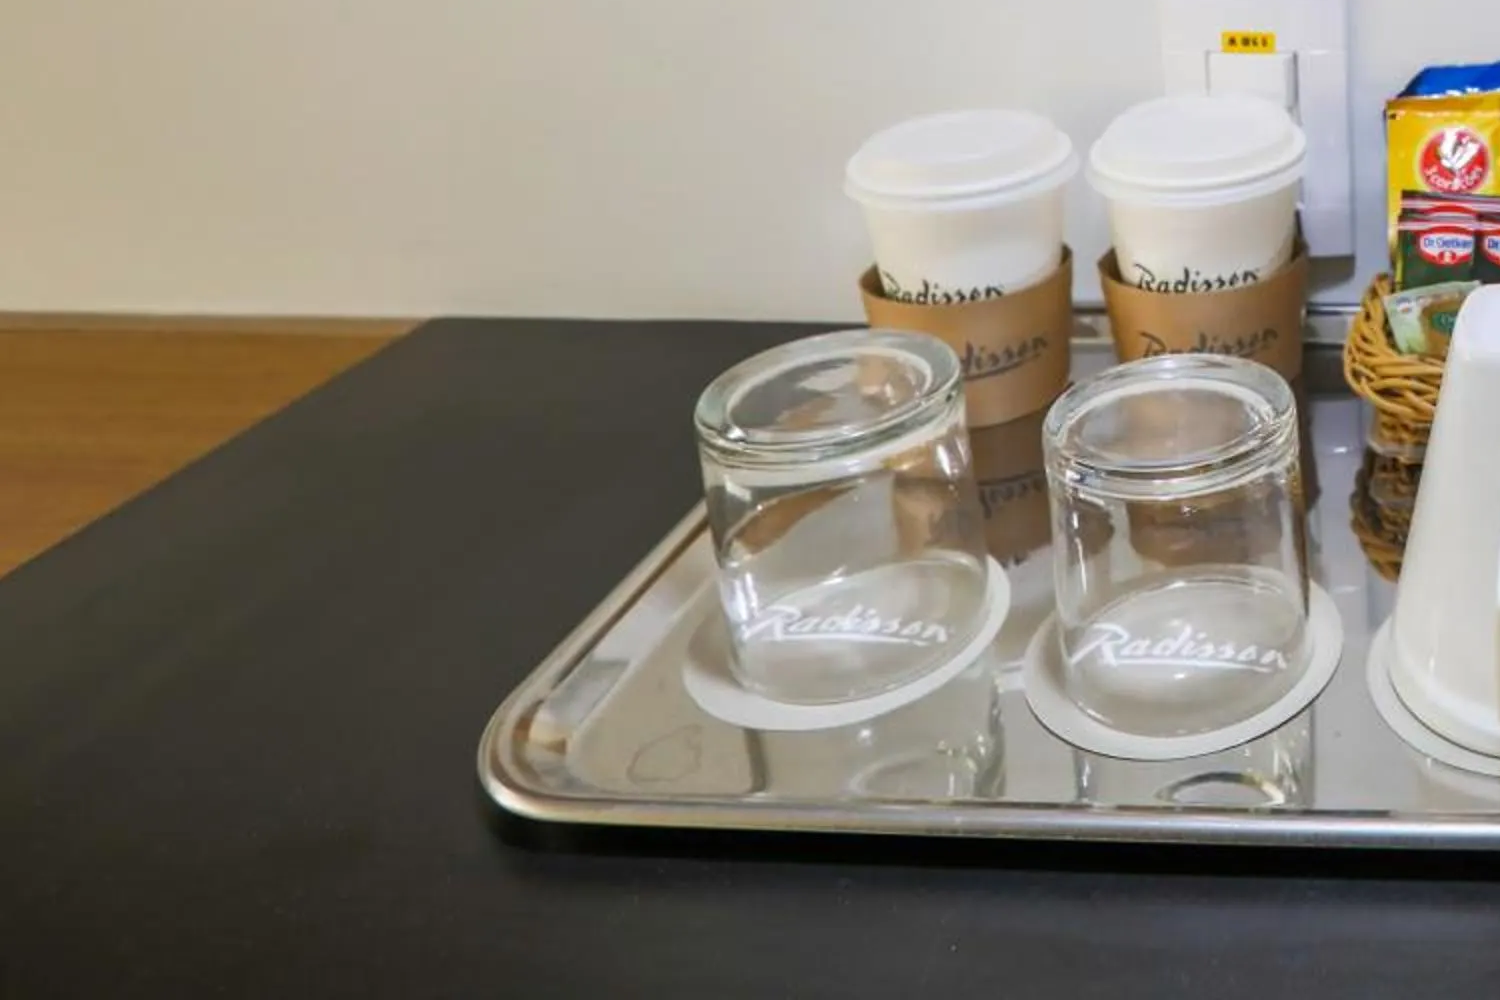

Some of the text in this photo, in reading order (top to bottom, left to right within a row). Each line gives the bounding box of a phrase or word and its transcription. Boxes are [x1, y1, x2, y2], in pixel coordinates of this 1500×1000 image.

[1134, 263, 1260, 294] Radisson
[743, 603, 948, 647] Radisson
[1071, 622, 1288, 672] Radisson
